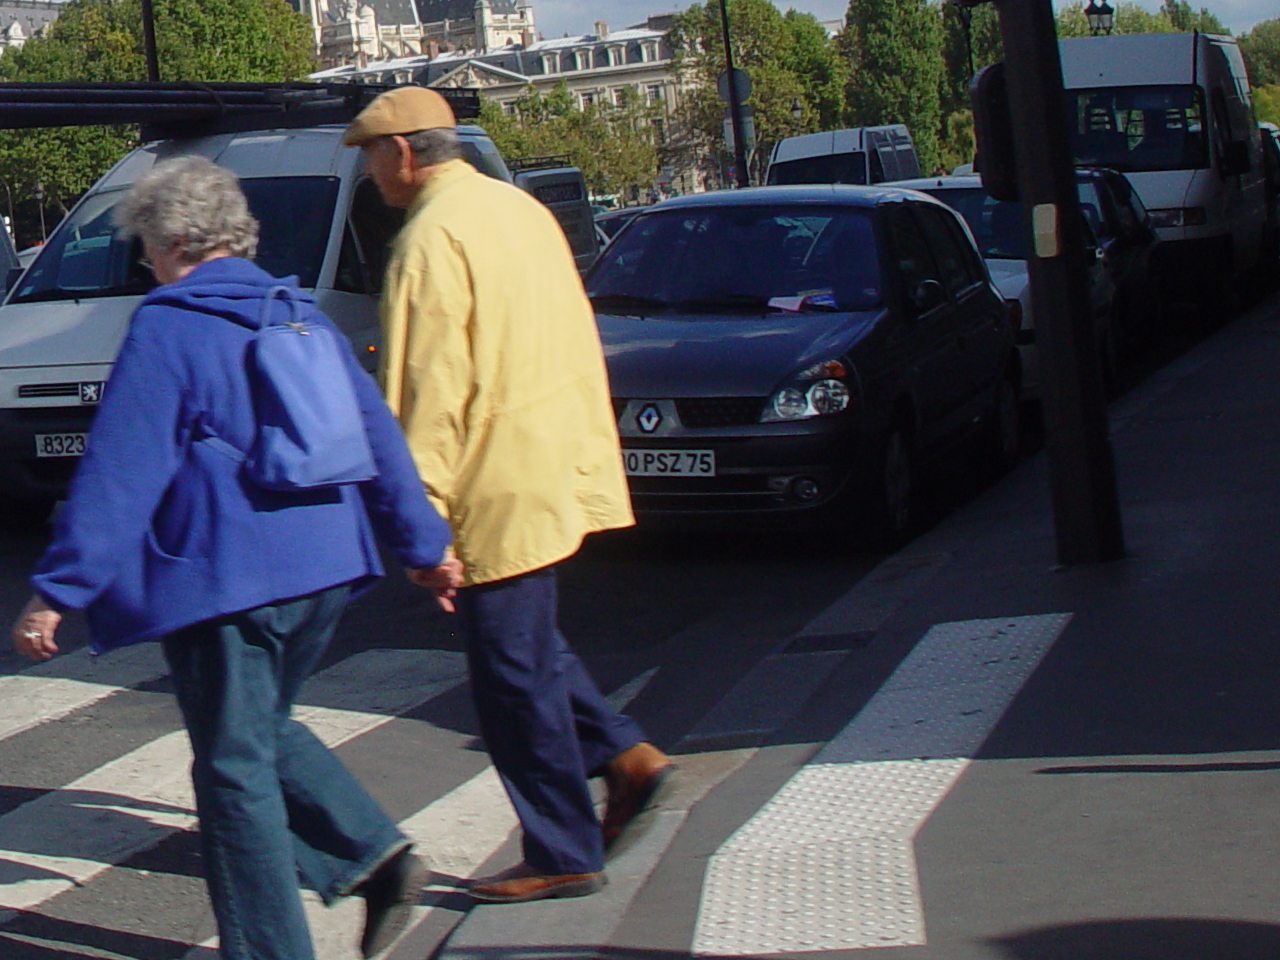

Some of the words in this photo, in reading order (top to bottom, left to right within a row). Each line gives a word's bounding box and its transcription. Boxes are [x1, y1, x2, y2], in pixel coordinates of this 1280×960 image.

[43, 435, 85, 454] 8323
[623, 452, 639, 472] 0
[643, 452, 682, 473] PSZ
[686, 452, 712, 473] 75
